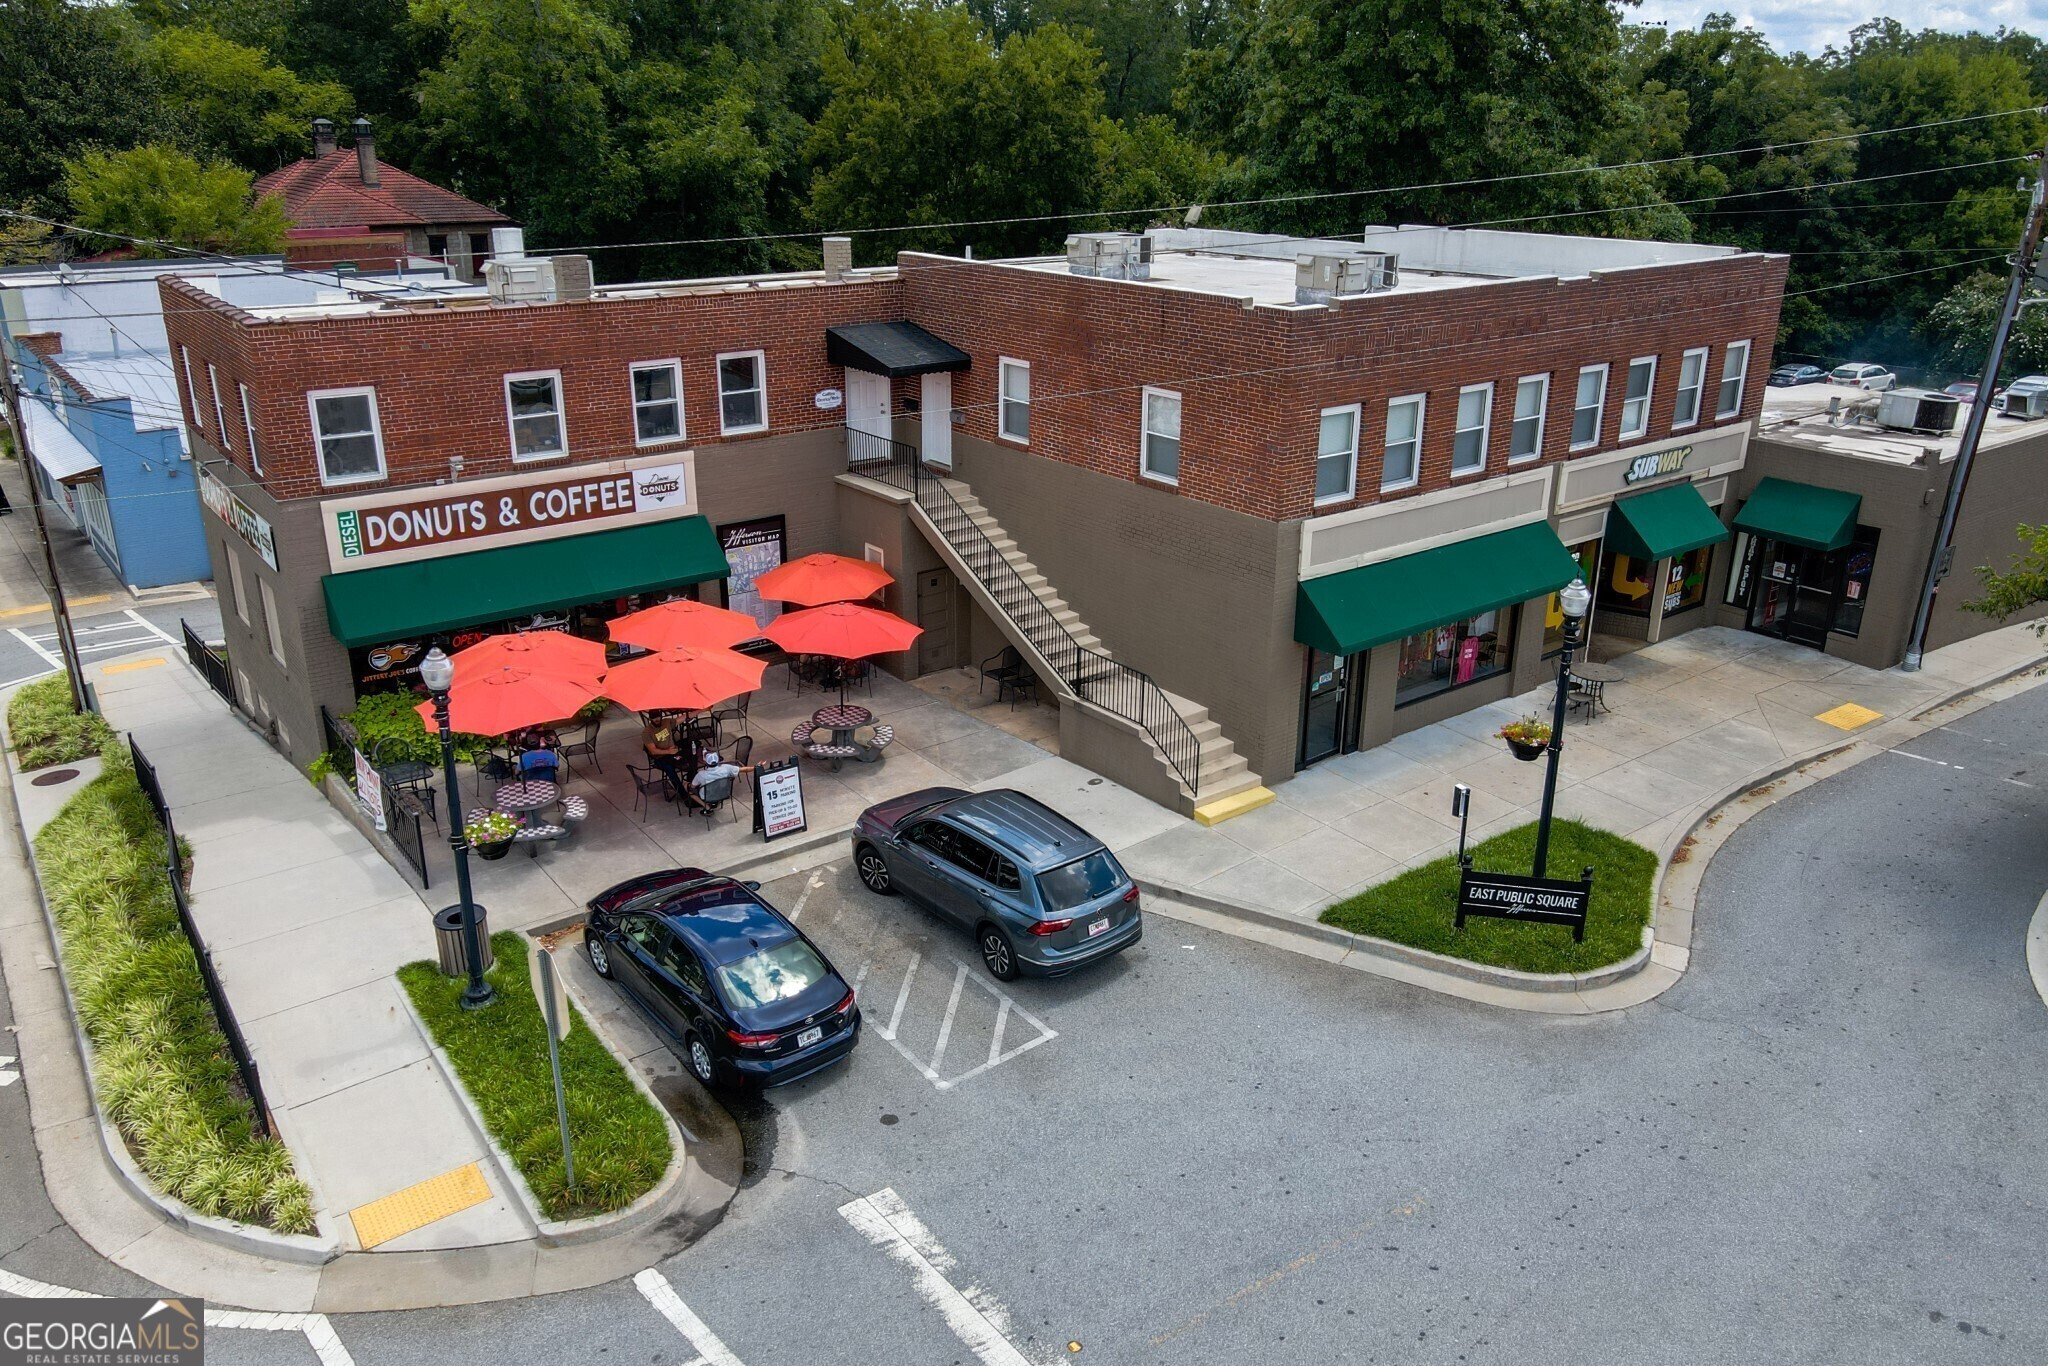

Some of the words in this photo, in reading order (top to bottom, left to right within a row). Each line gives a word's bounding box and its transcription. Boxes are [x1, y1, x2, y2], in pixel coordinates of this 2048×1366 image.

[1628, 447, 1692, 481] SUBWAY
[642, 482, 676, 495] DONUTS
[365, 500, 487, 548] DONUTS
[498, 496, 521, 527] &
[529, 478, 633, 522] COFFEE
[339, 511, 360, 558] DIESEL
[742, 536, 766, 545] VISITOR
[767, 533, 780, 541] MAP
[1672, 565, 1683, 582] 12
[452, 633, 482, 648] OPEN
[361, 672, 389, 682] JITTERY
[767, 790, 778, 801] 15
[1469, 887, 1496, 900] EAST
[1496, 889, 1534, 904] PUBLIC
[1536, 894, 1579, 909] SQUARE
